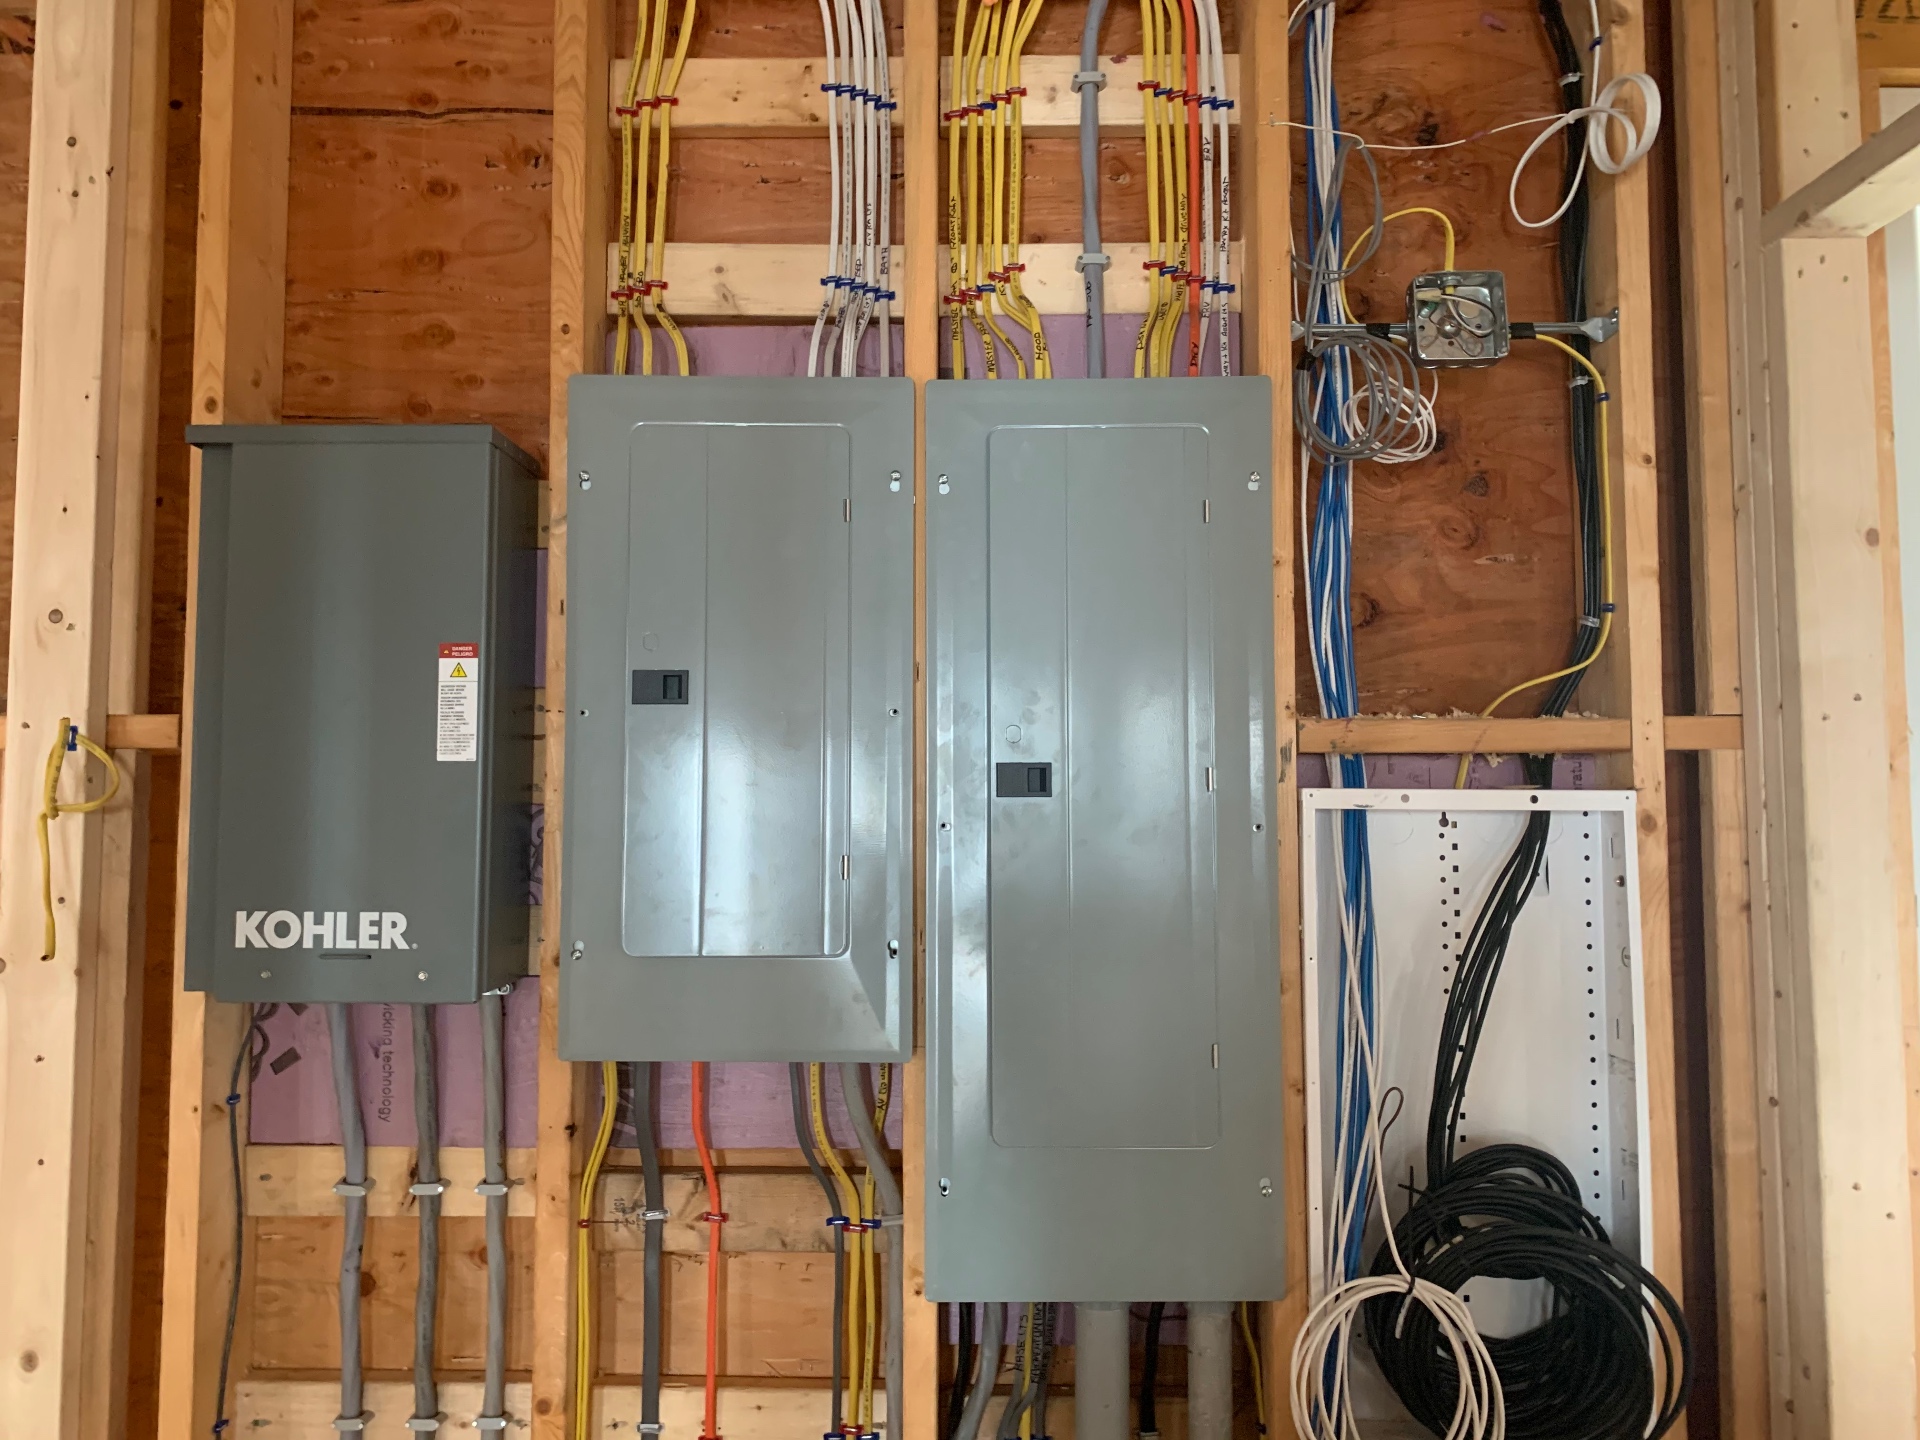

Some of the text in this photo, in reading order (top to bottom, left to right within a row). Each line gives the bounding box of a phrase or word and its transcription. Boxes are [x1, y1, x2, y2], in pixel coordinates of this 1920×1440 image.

[984, 341, 996, 373] MASTER
[1033, 332, 1044, 361] HOOD
[235, 910, 410, 950] KOHLER
[377, 1051, 396, 1123] technology
